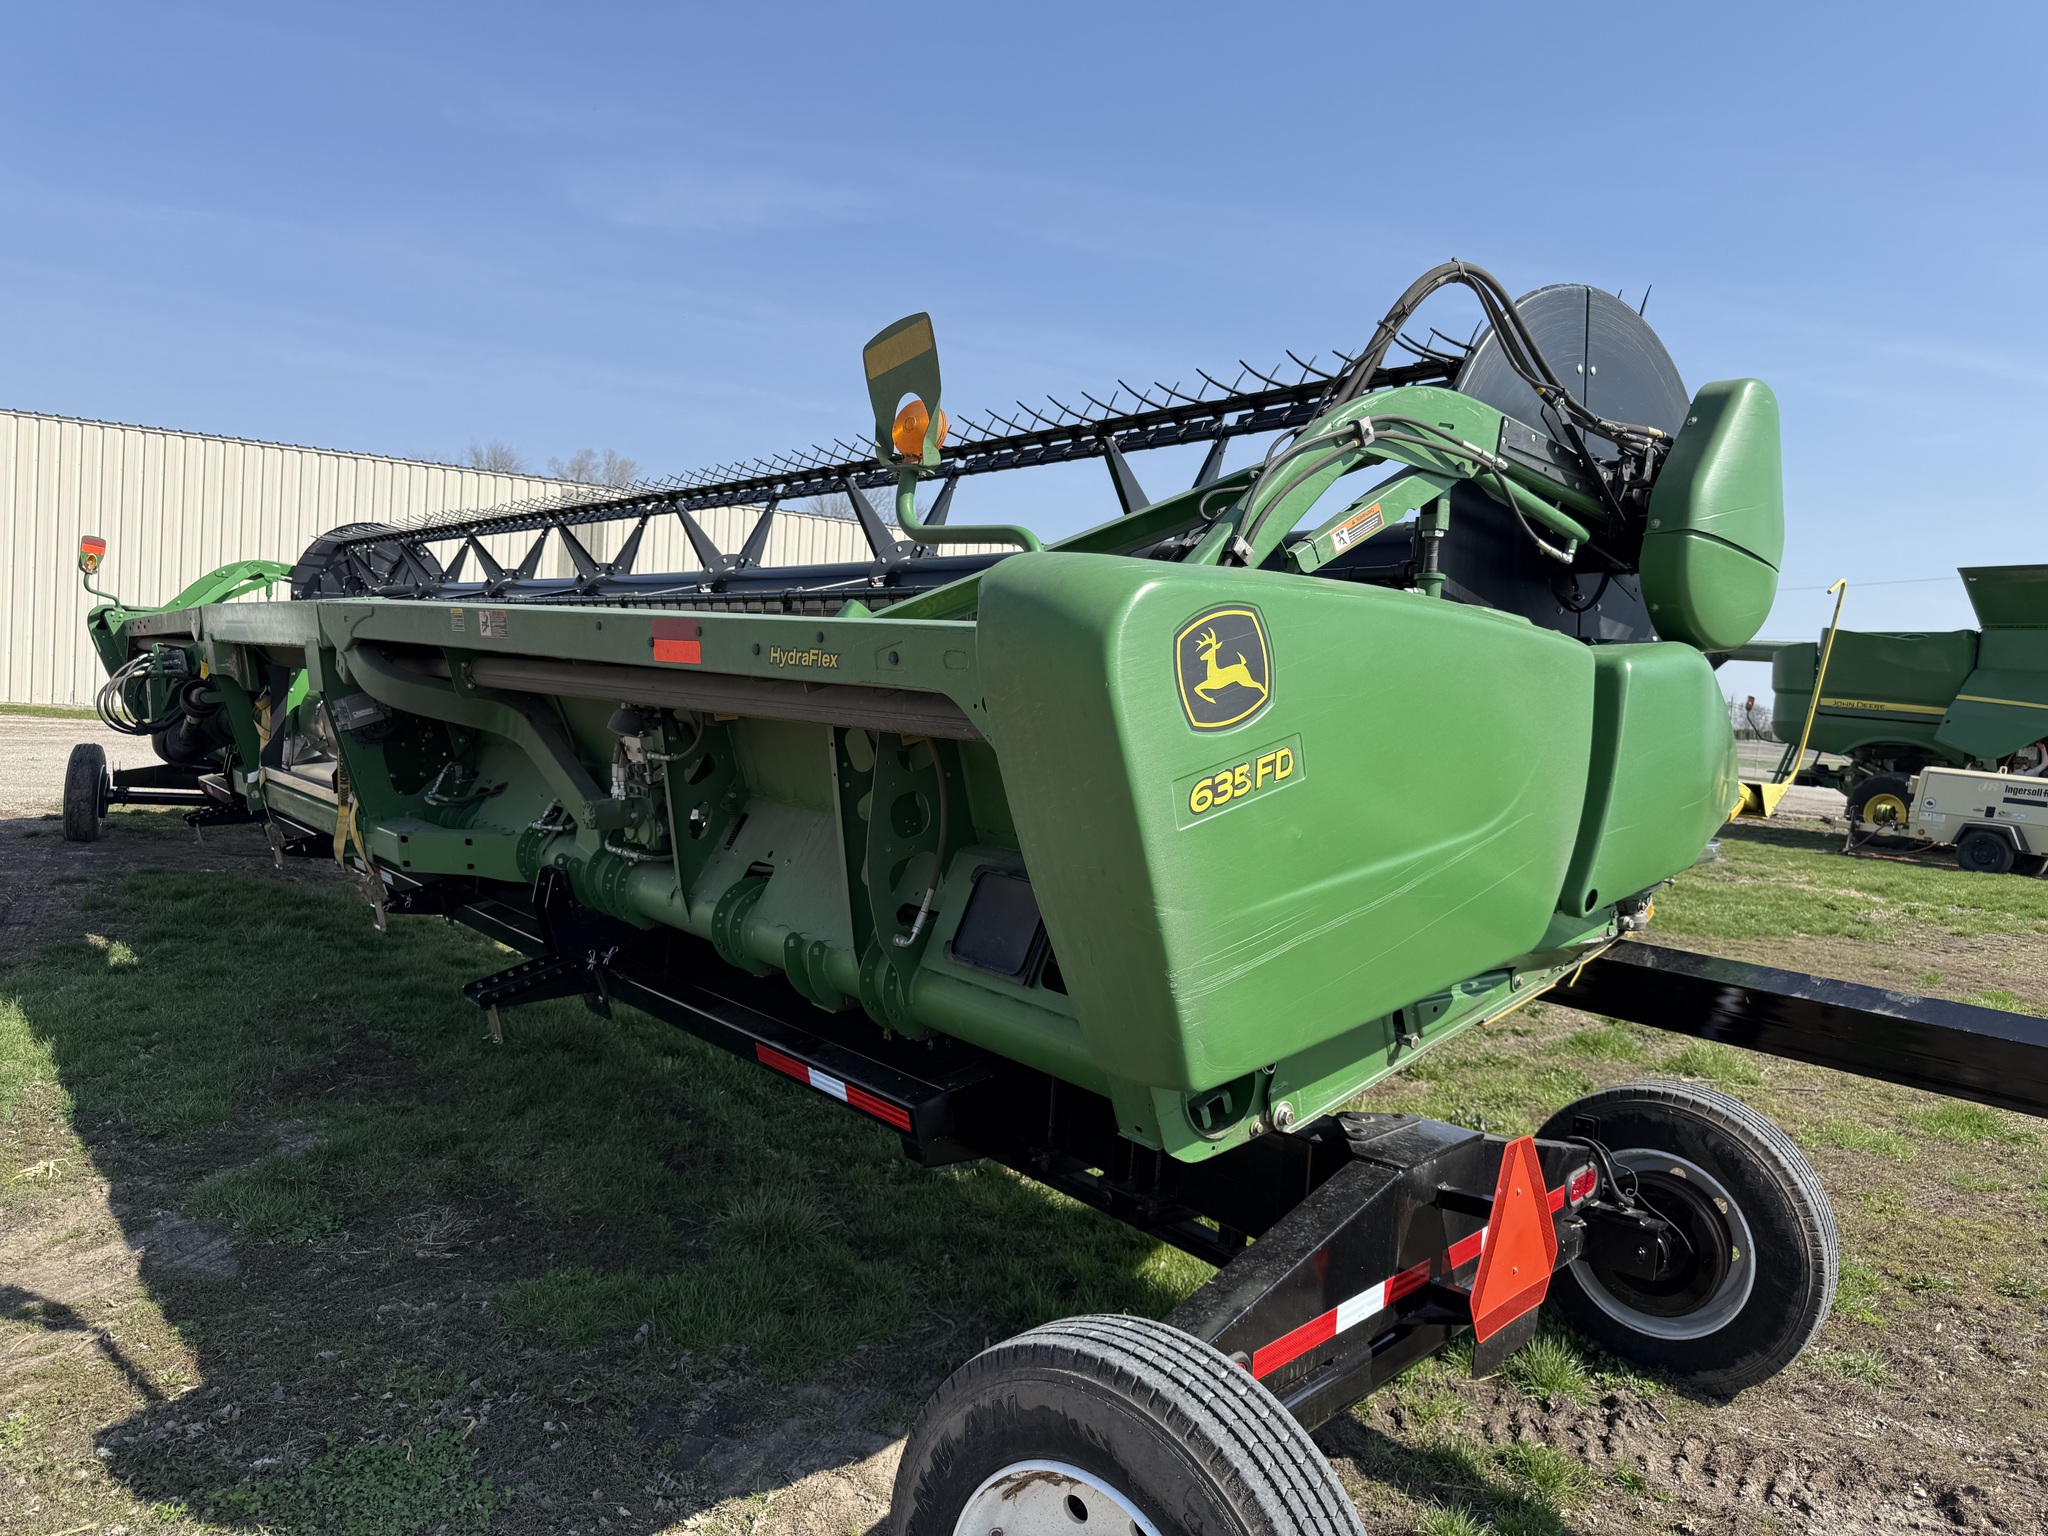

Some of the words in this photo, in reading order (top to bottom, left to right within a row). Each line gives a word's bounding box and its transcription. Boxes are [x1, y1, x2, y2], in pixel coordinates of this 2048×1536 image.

[769, 646, 840, 669] HydraFlex
[1834, 700, 1855, 708] JOHN
[1856, 701, 1886, 710] DEERE
